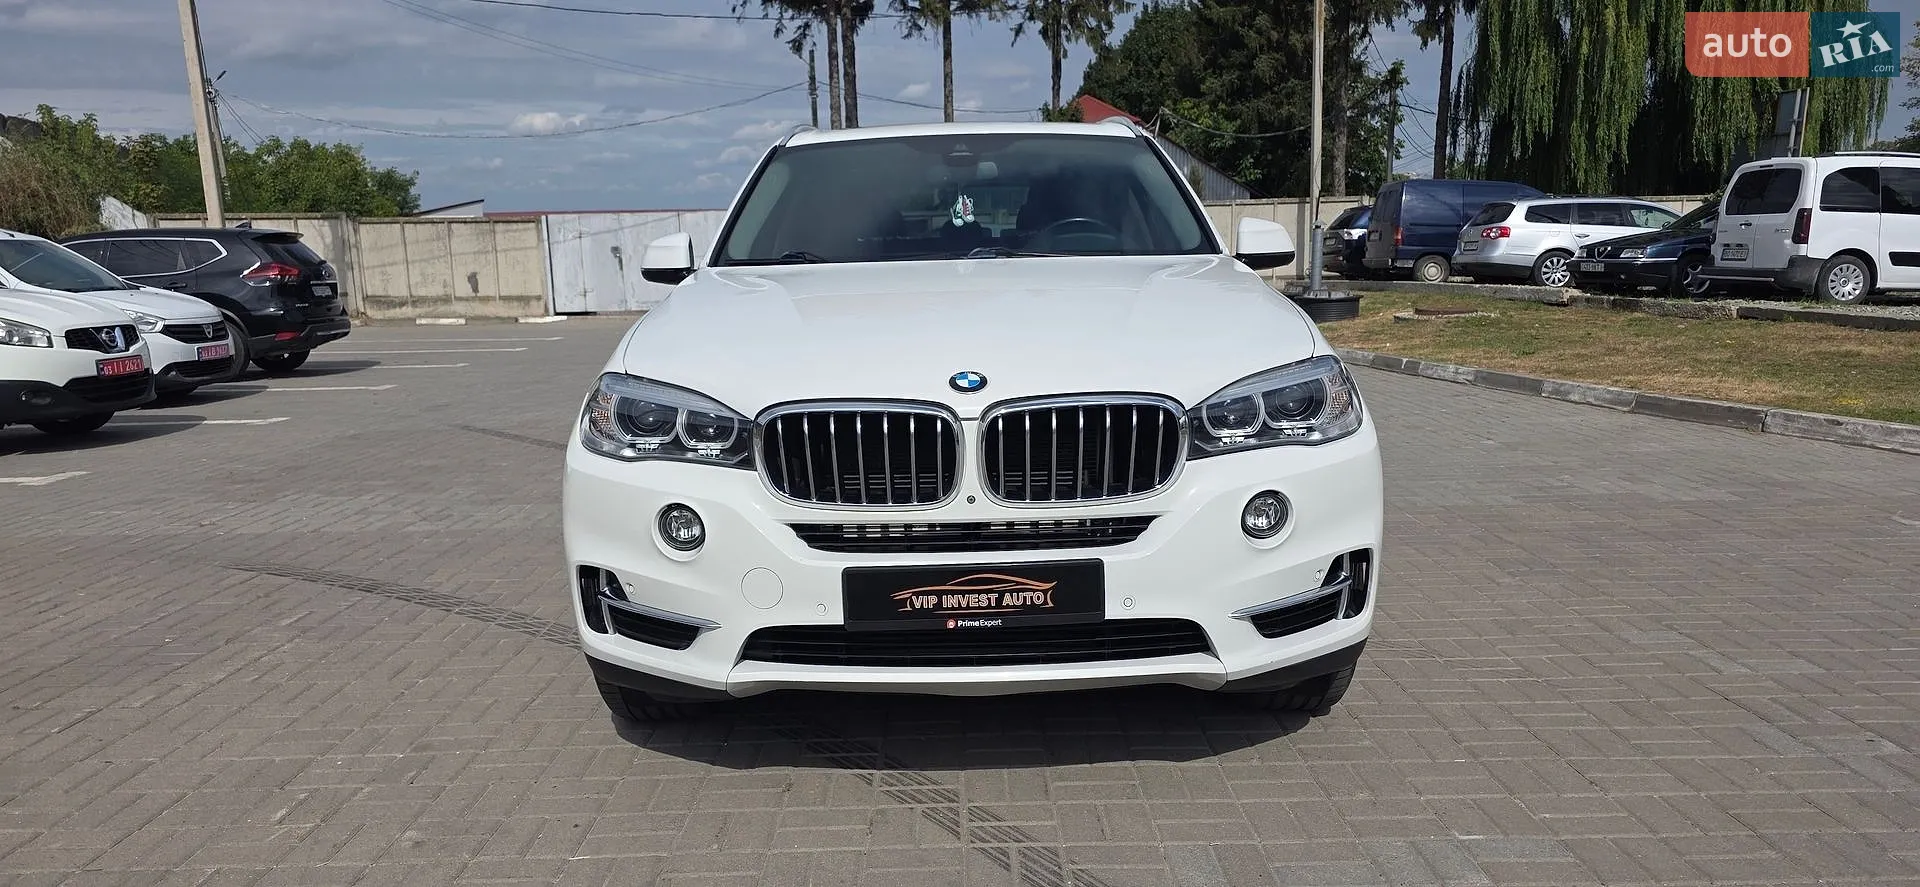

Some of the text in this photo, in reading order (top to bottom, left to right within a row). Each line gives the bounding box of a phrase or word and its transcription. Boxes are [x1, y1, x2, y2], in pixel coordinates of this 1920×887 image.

[103, 365, 112, 375] 03
[125, 358, 142, 371] 2621
[912, 591, 1045, 609] VIP INVEST AUTO
